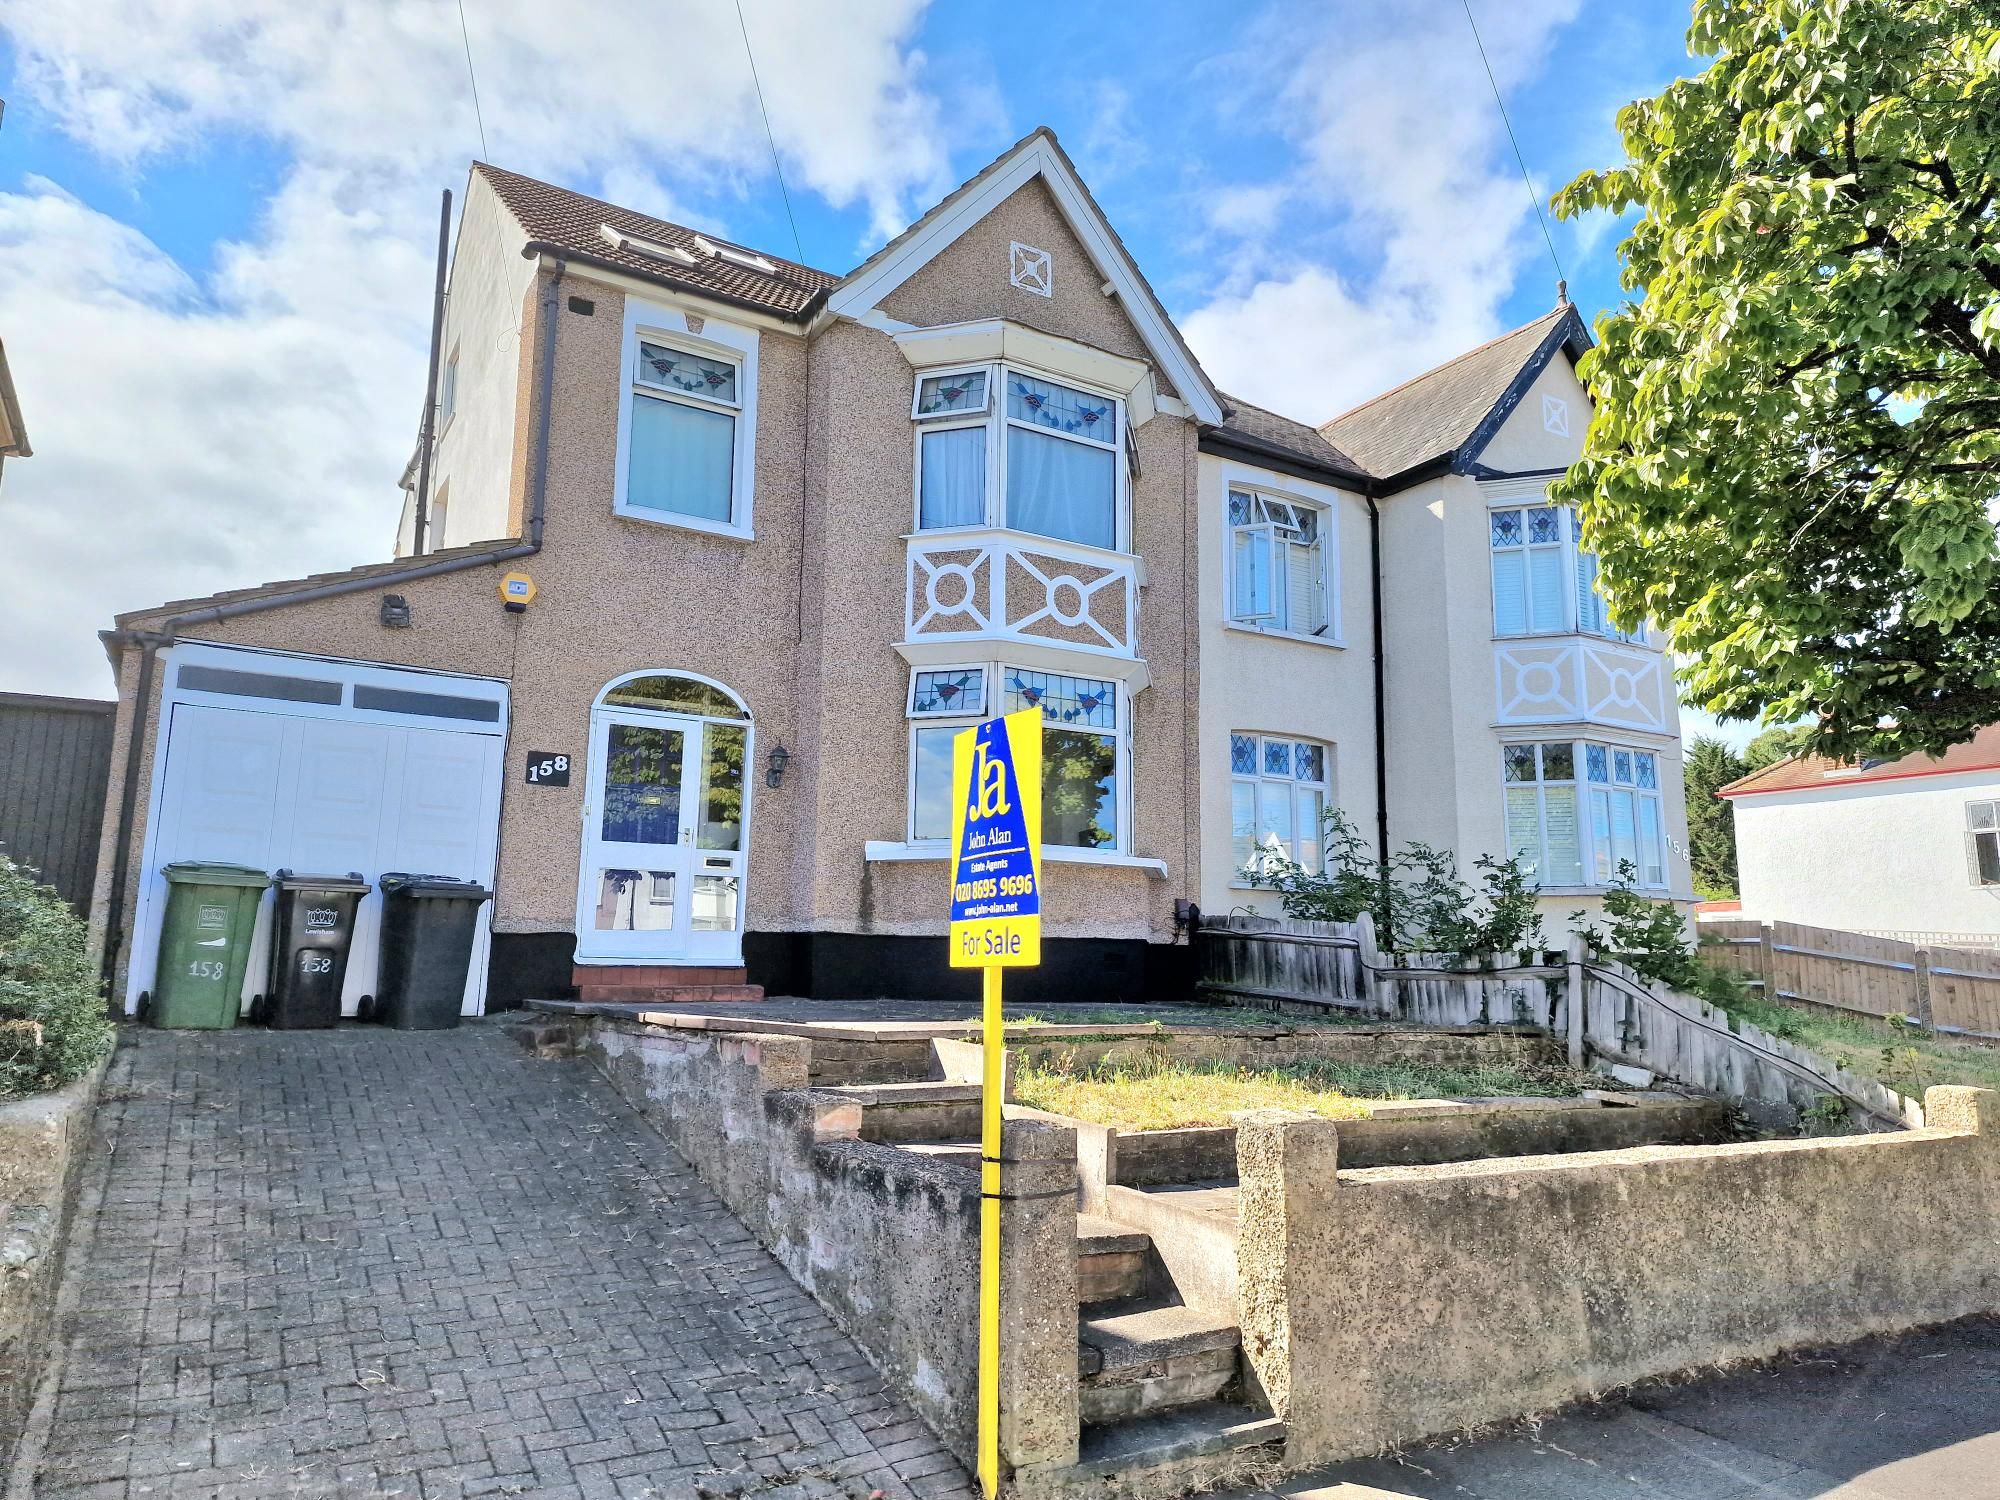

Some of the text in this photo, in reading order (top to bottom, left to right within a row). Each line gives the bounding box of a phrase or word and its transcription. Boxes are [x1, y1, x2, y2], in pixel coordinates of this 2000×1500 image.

[529, 755, 568, 782] 158
[969, 740, 1011, 822] Ja
[968, 826, 1012, 850] John Alan
[1665, 834, 1689, 862] 156
[970, 859, 1008, 873] Estate Agents
[956, 873, 1032, 902] 020 8695 9696
[964, 901, 1018, 917] www.john-alan.net
[305, 928, 335, 936] Lewisham
[962, 925, 1021, 956] For Sale
[188, 960, 224, 980] 158
[301, 957, 331, 973] 158
